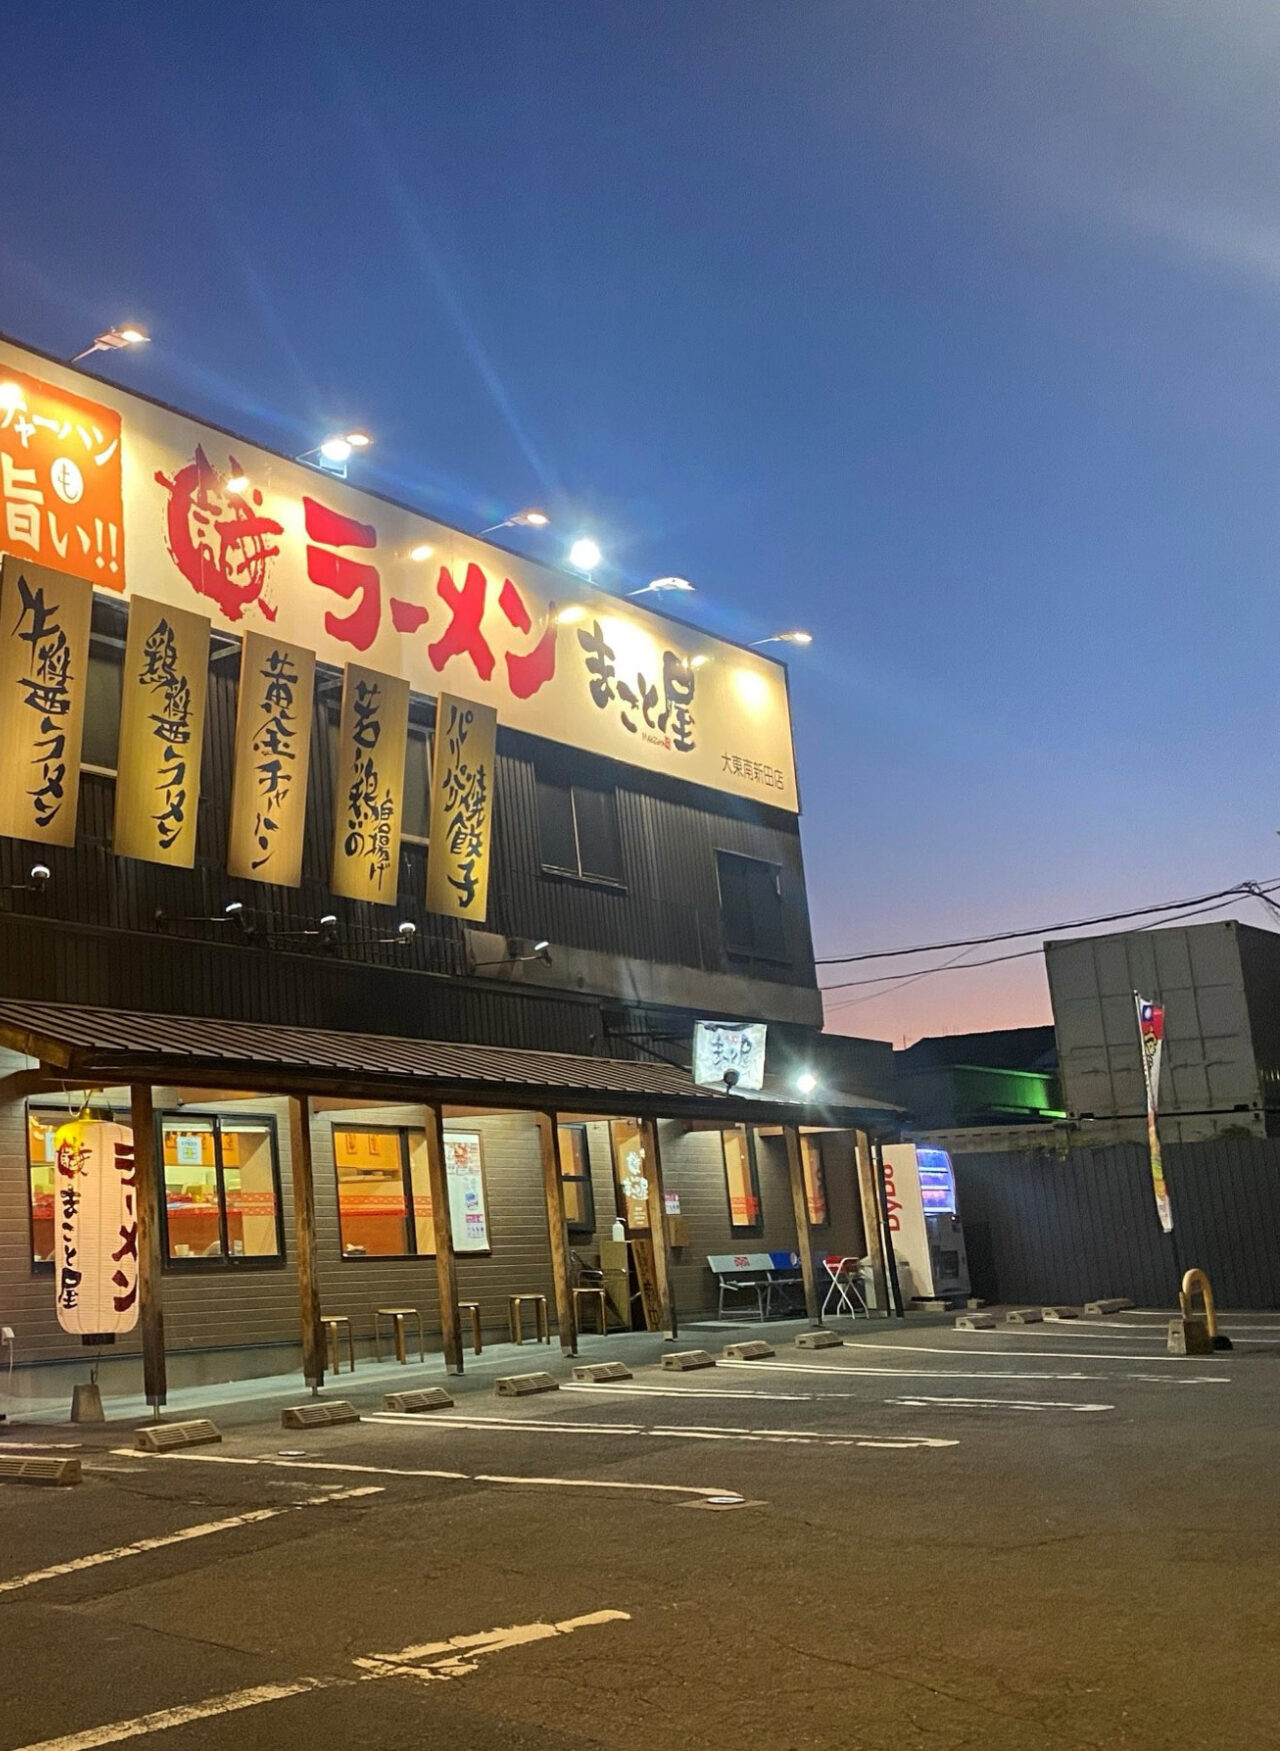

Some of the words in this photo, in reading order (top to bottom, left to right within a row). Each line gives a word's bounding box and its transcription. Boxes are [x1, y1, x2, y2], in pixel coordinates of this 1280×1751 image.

[54, 460, 81, 502] も
[303, 496, 558, 699] ラーメン
[577, 619, 696, 752] まこと屋
[721, 752, 784, 790] 大東南新田店
[58, 1185, 82, 1310] まこと屋
